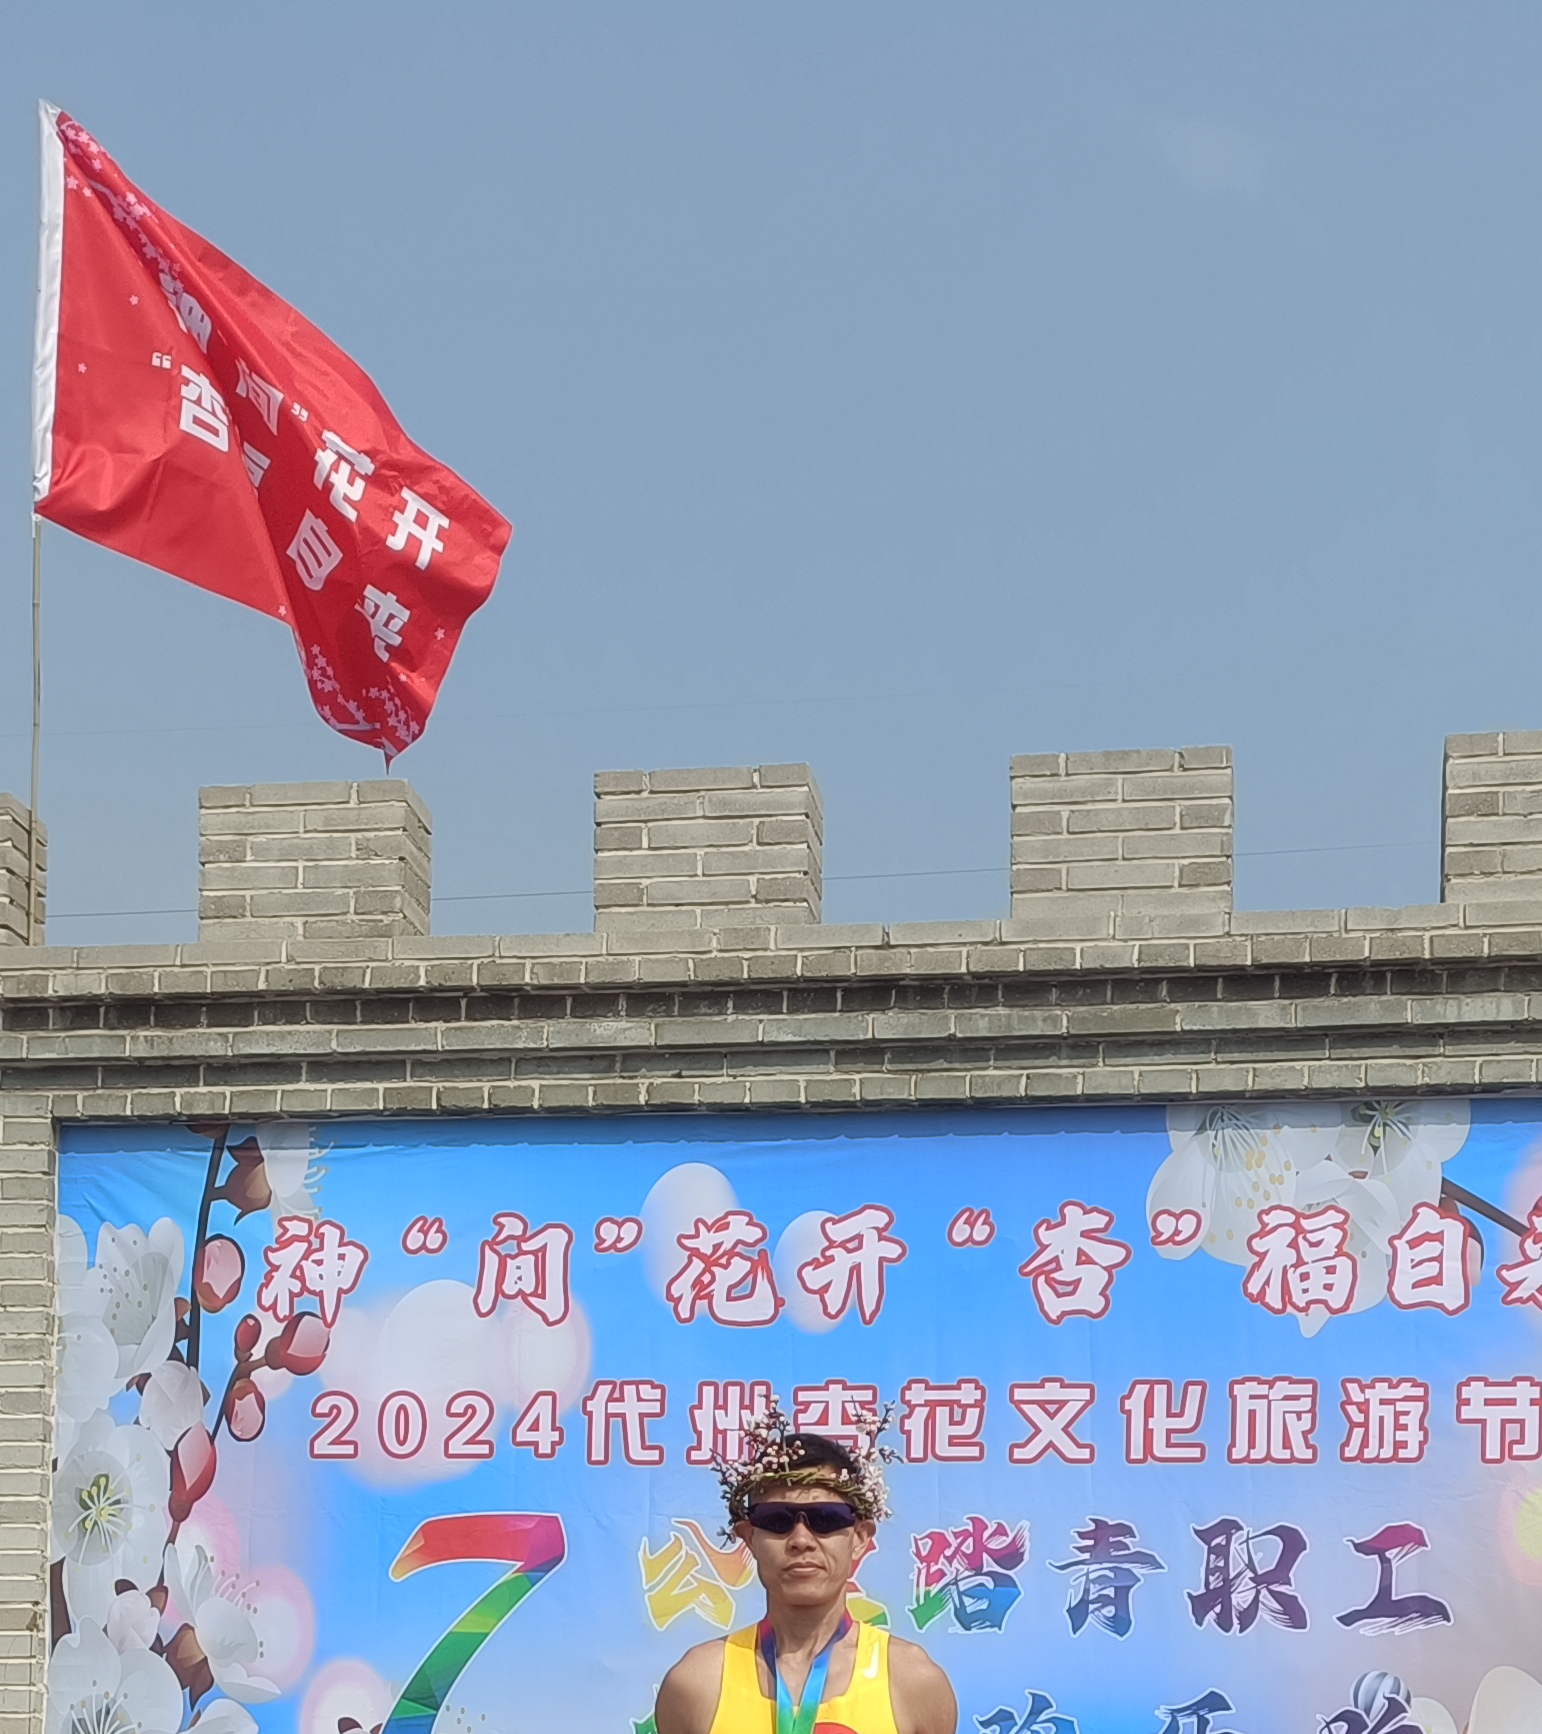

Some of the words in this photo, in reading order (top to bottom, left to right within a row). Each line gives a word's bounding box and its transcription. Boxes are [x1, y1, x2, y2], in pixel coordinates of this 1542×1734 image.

[640, 1514, 1452, 1639] 公踏青职工
